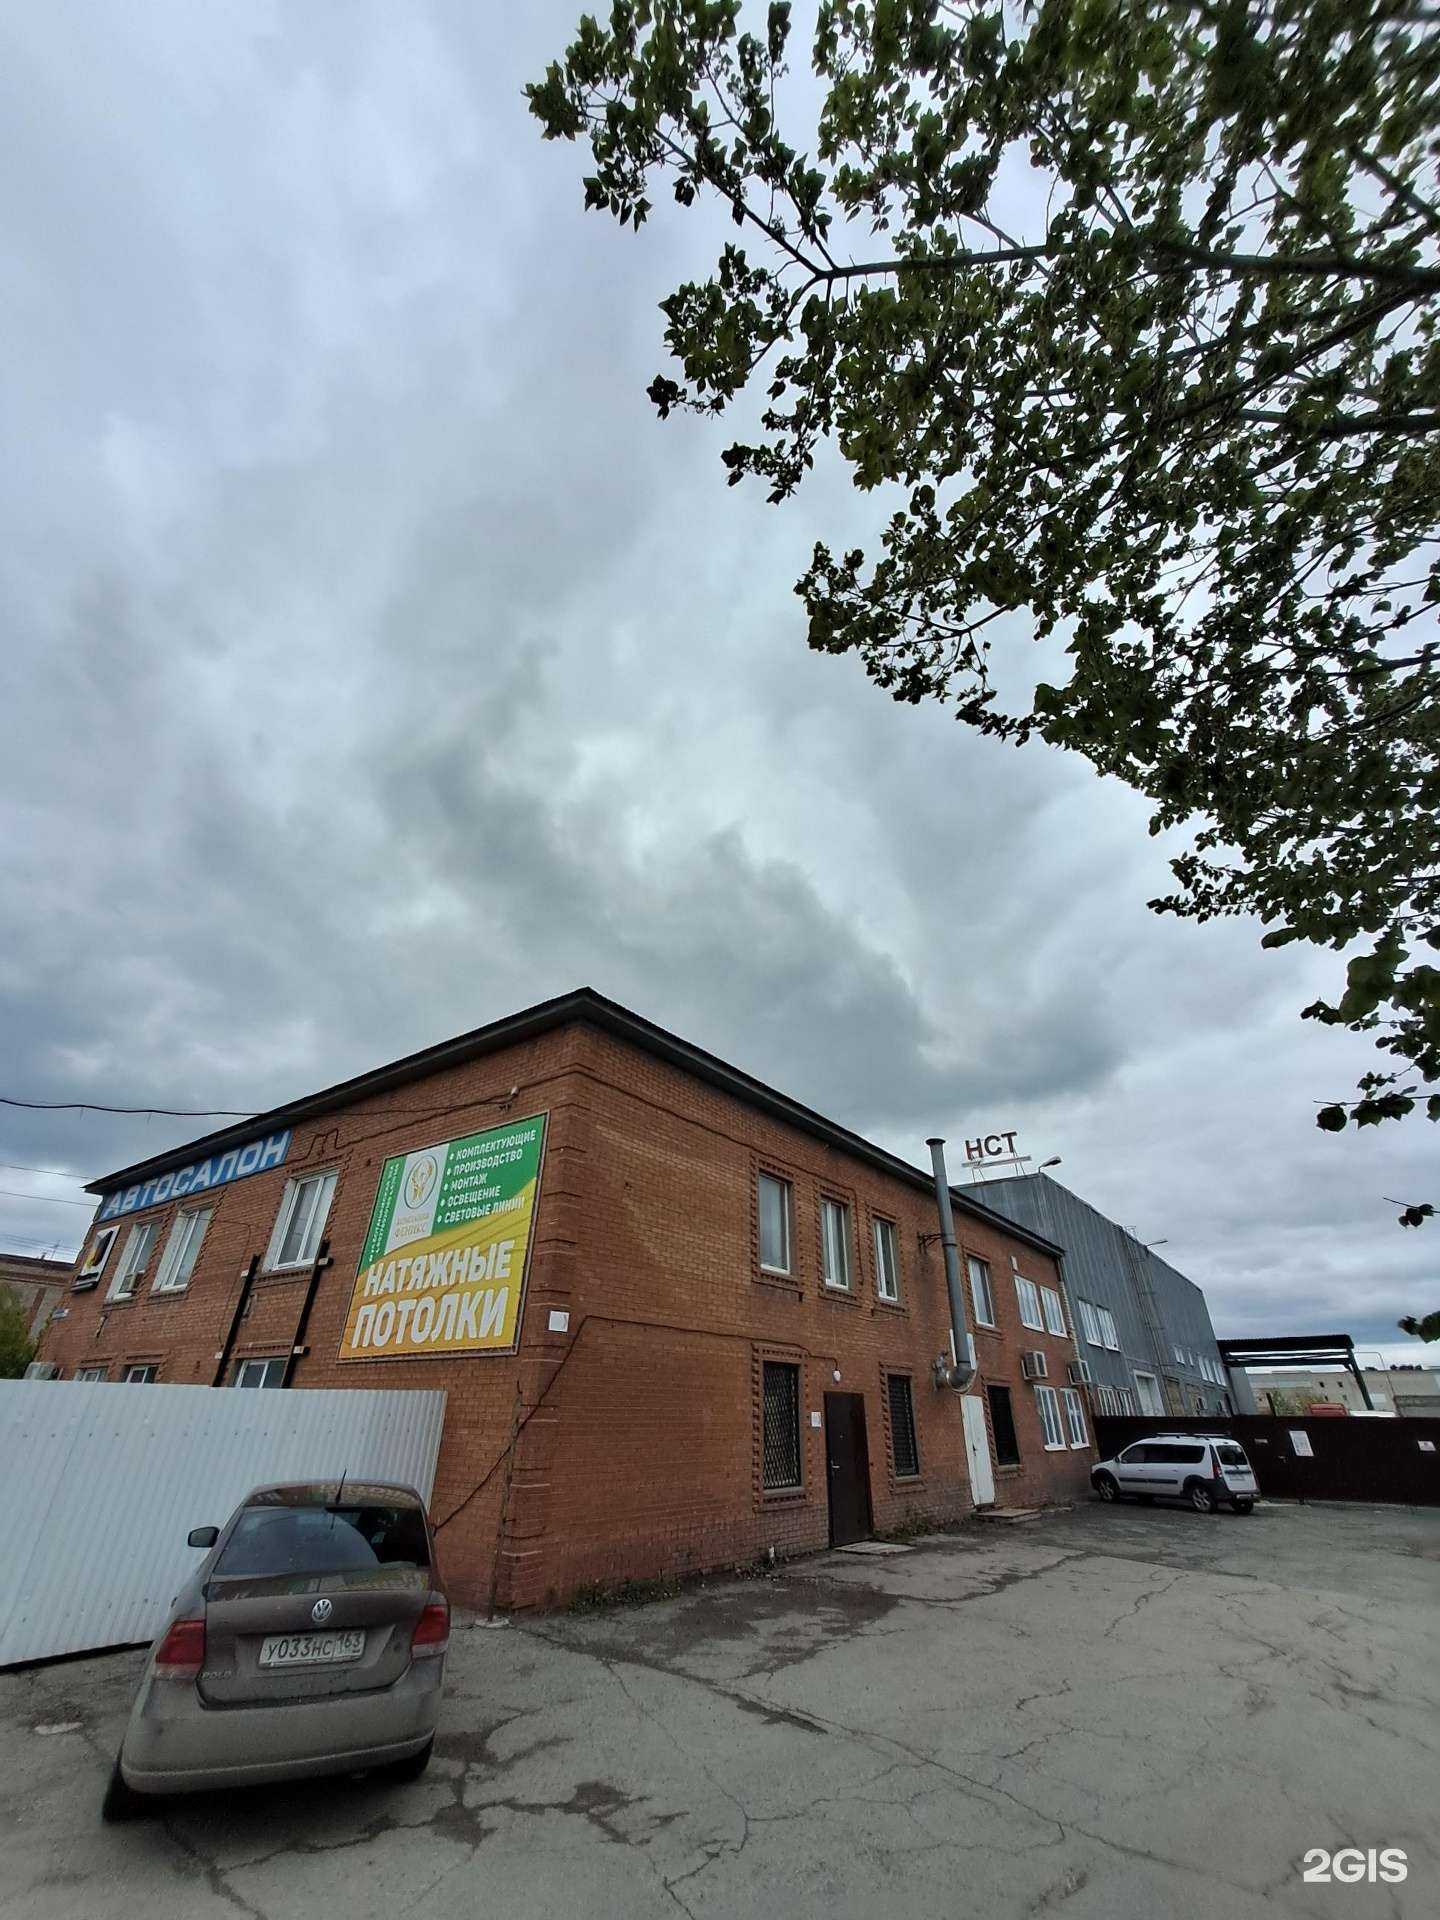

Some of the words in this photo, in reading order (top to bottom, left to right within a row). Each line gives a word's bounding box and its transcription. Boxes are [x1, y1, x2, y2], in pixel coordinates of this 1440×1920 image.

[456, 1130, 536, 1160] КОМПЛЕКТУЮЩИЕ
[965, 1131, 1017, 1160] НСТ
[103, 1129, 290, 1218] АВТОСАЛОН
[453, 1149, 523, 1176] ПРОИЗВОДСТВО
[447, 1186, 501, 1207] ОСВЕЩЕНИЕ
[450, 1173, 488, 1192] МОНТАЖ
[444, 1204, 491, 1223] СВЕТОВЫЕ
[491, 1196, 525, 1215] ЛИНИИ
[363, 1240, 515, 1297] НАТЯЖНЫЕ
[351, 1287, 509, 1348] ПОТОЛКИ
